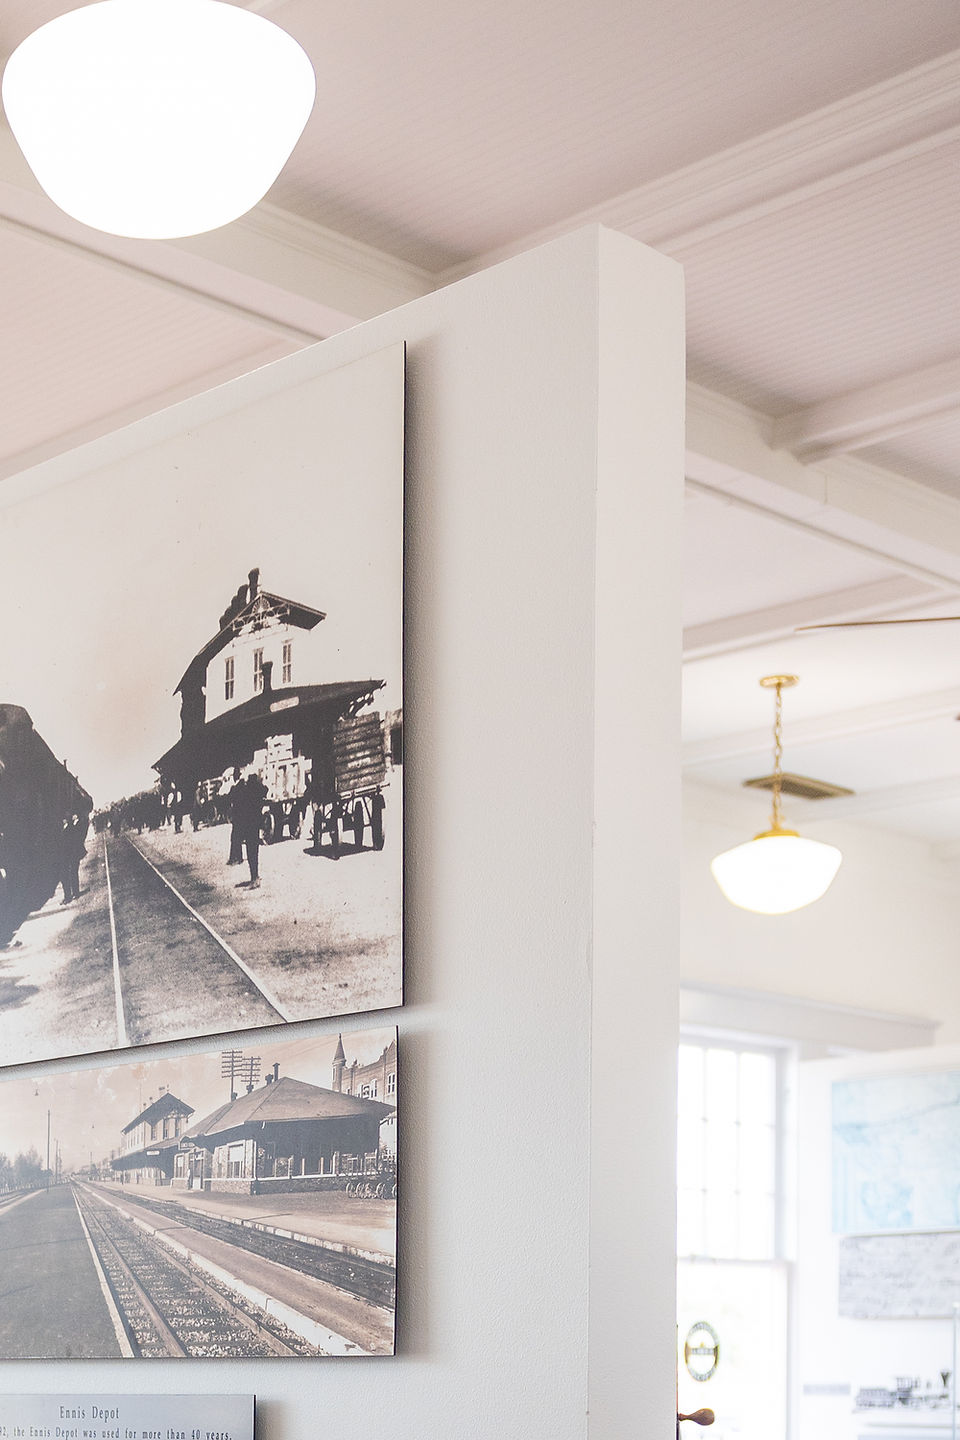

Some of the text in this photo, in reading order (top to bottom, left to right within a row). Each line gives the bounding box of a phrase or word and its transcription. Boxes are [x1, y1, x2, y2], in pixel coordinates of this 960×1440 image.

[60, 1406, 119, 1423] Ennis Depot
[14, 1426, 24, 1436] the
[30, 1426, 50, 1437] Ennis
[56, 1426, 78, 1440] Depot
[82, 1430, 96, 1438] was
[102, 1428, 119, 1438] used
[125, 1428, 136, 1439] for
[142, 1431, 161, 1439] more
[167, 1428, 185, 1440] than
[192, 1429, 200, 1440] 40
